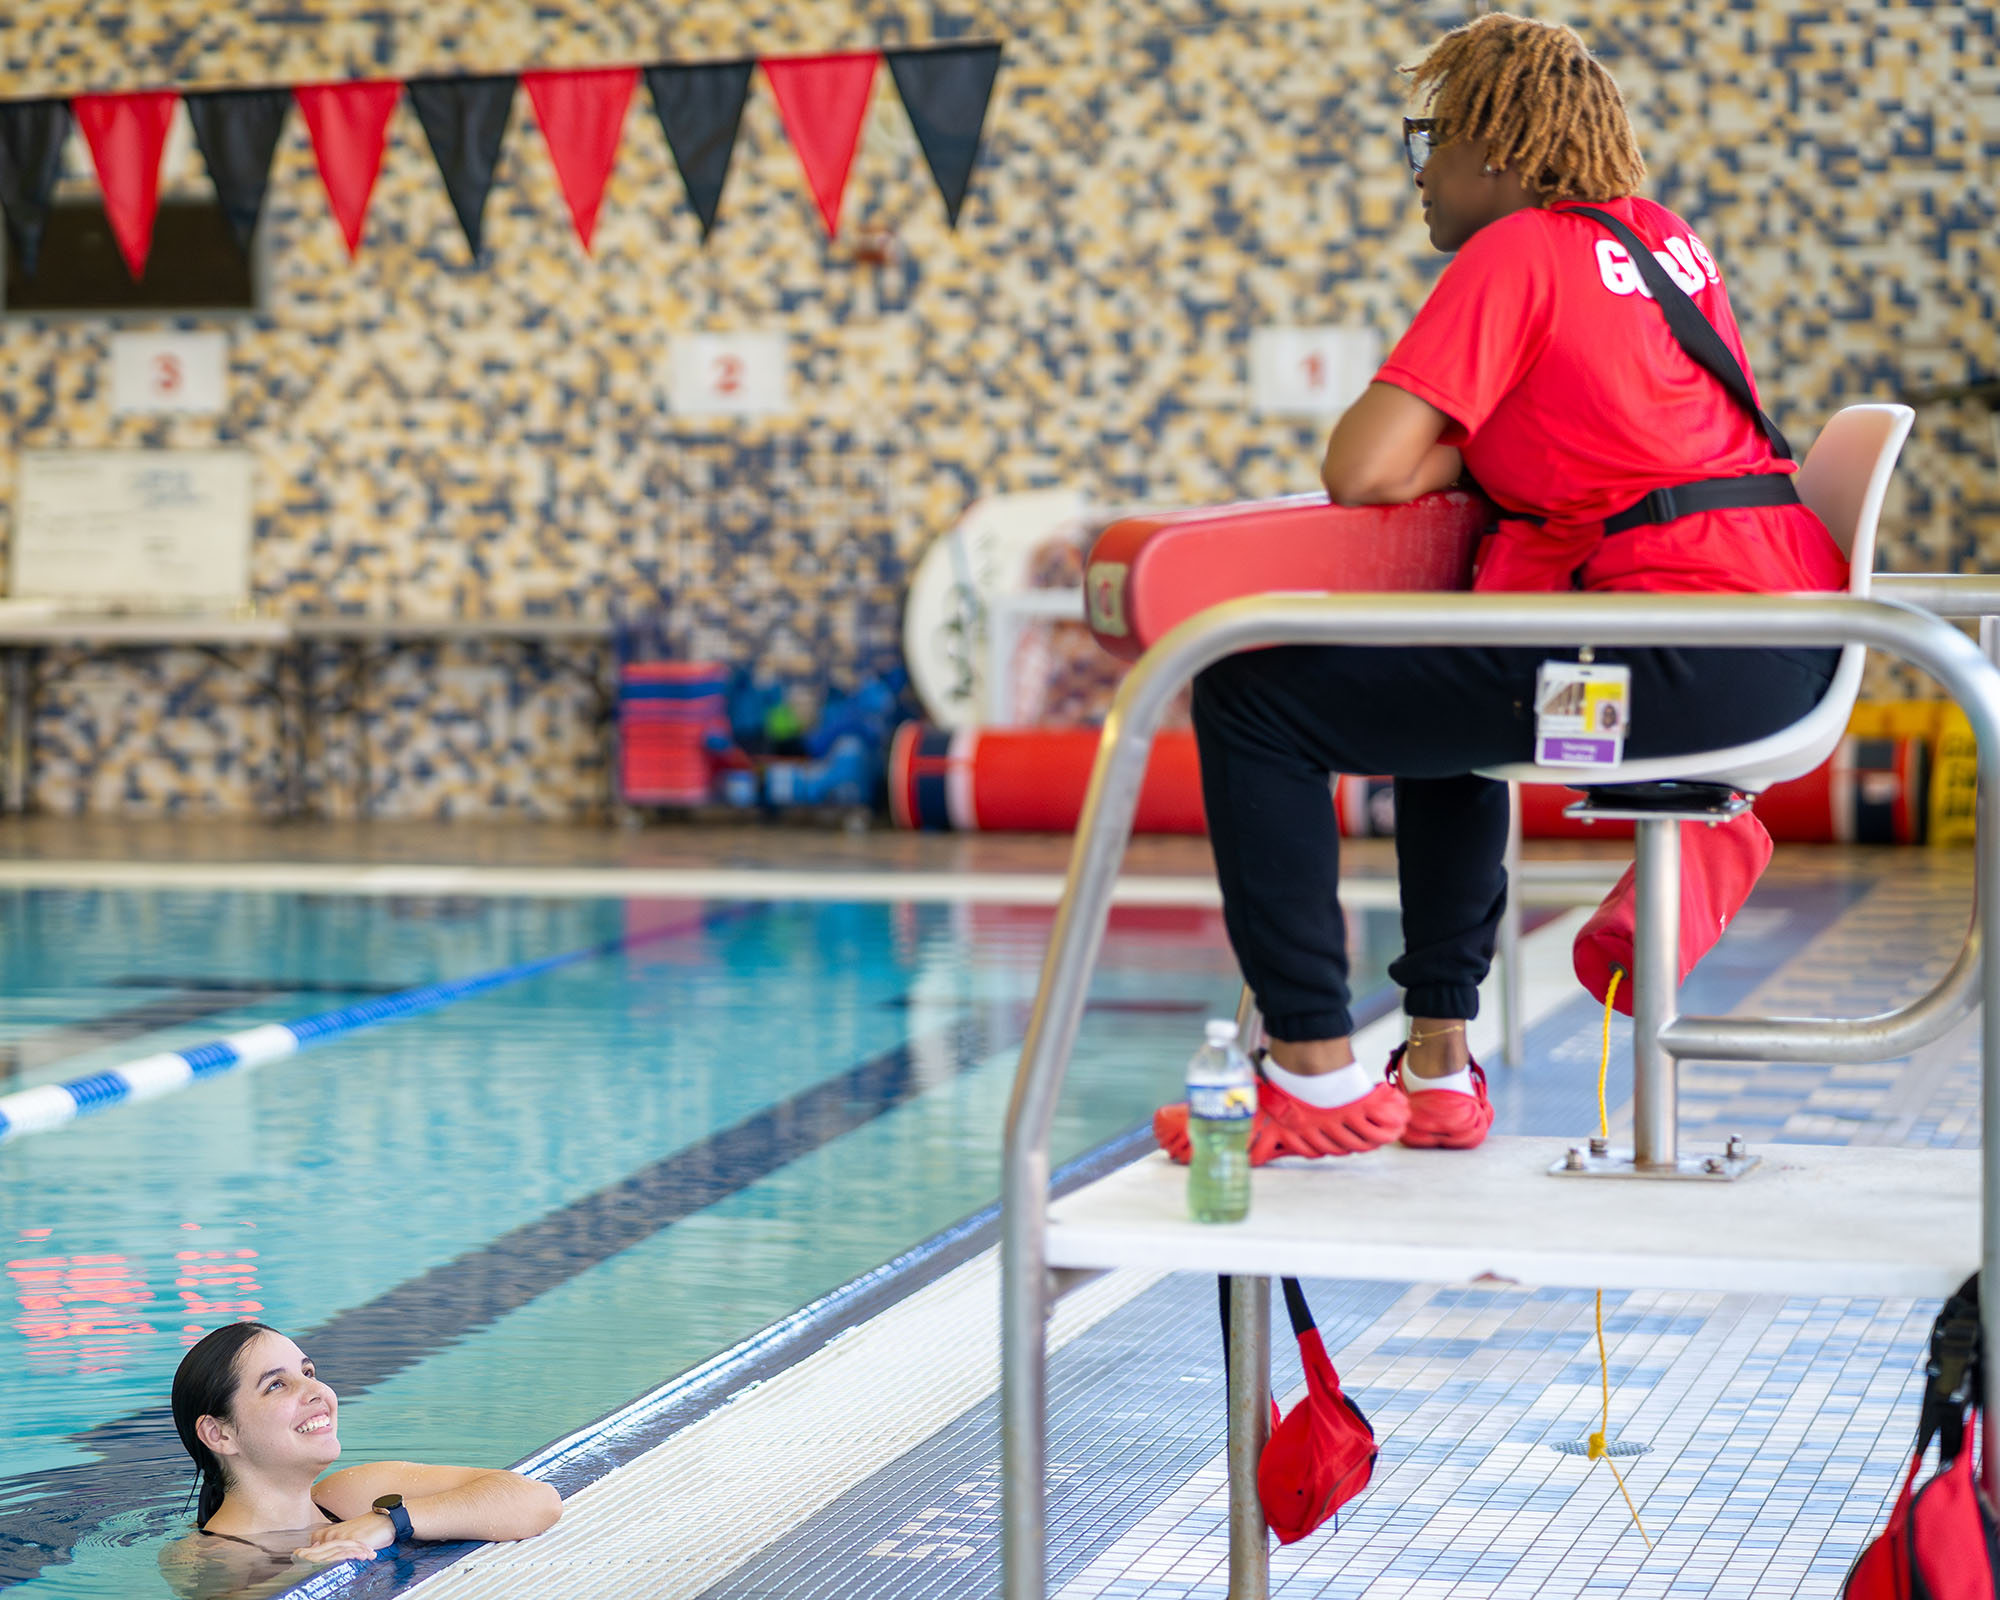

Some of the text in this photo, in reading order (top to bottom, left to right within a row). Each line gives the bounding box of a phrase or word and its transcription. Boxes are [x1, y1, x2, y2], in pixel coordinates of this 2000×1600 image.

[152, 352, 185, 396] 3
[713, 354, 745, 396] 2
[1300, 351, 1327, 391] 1
